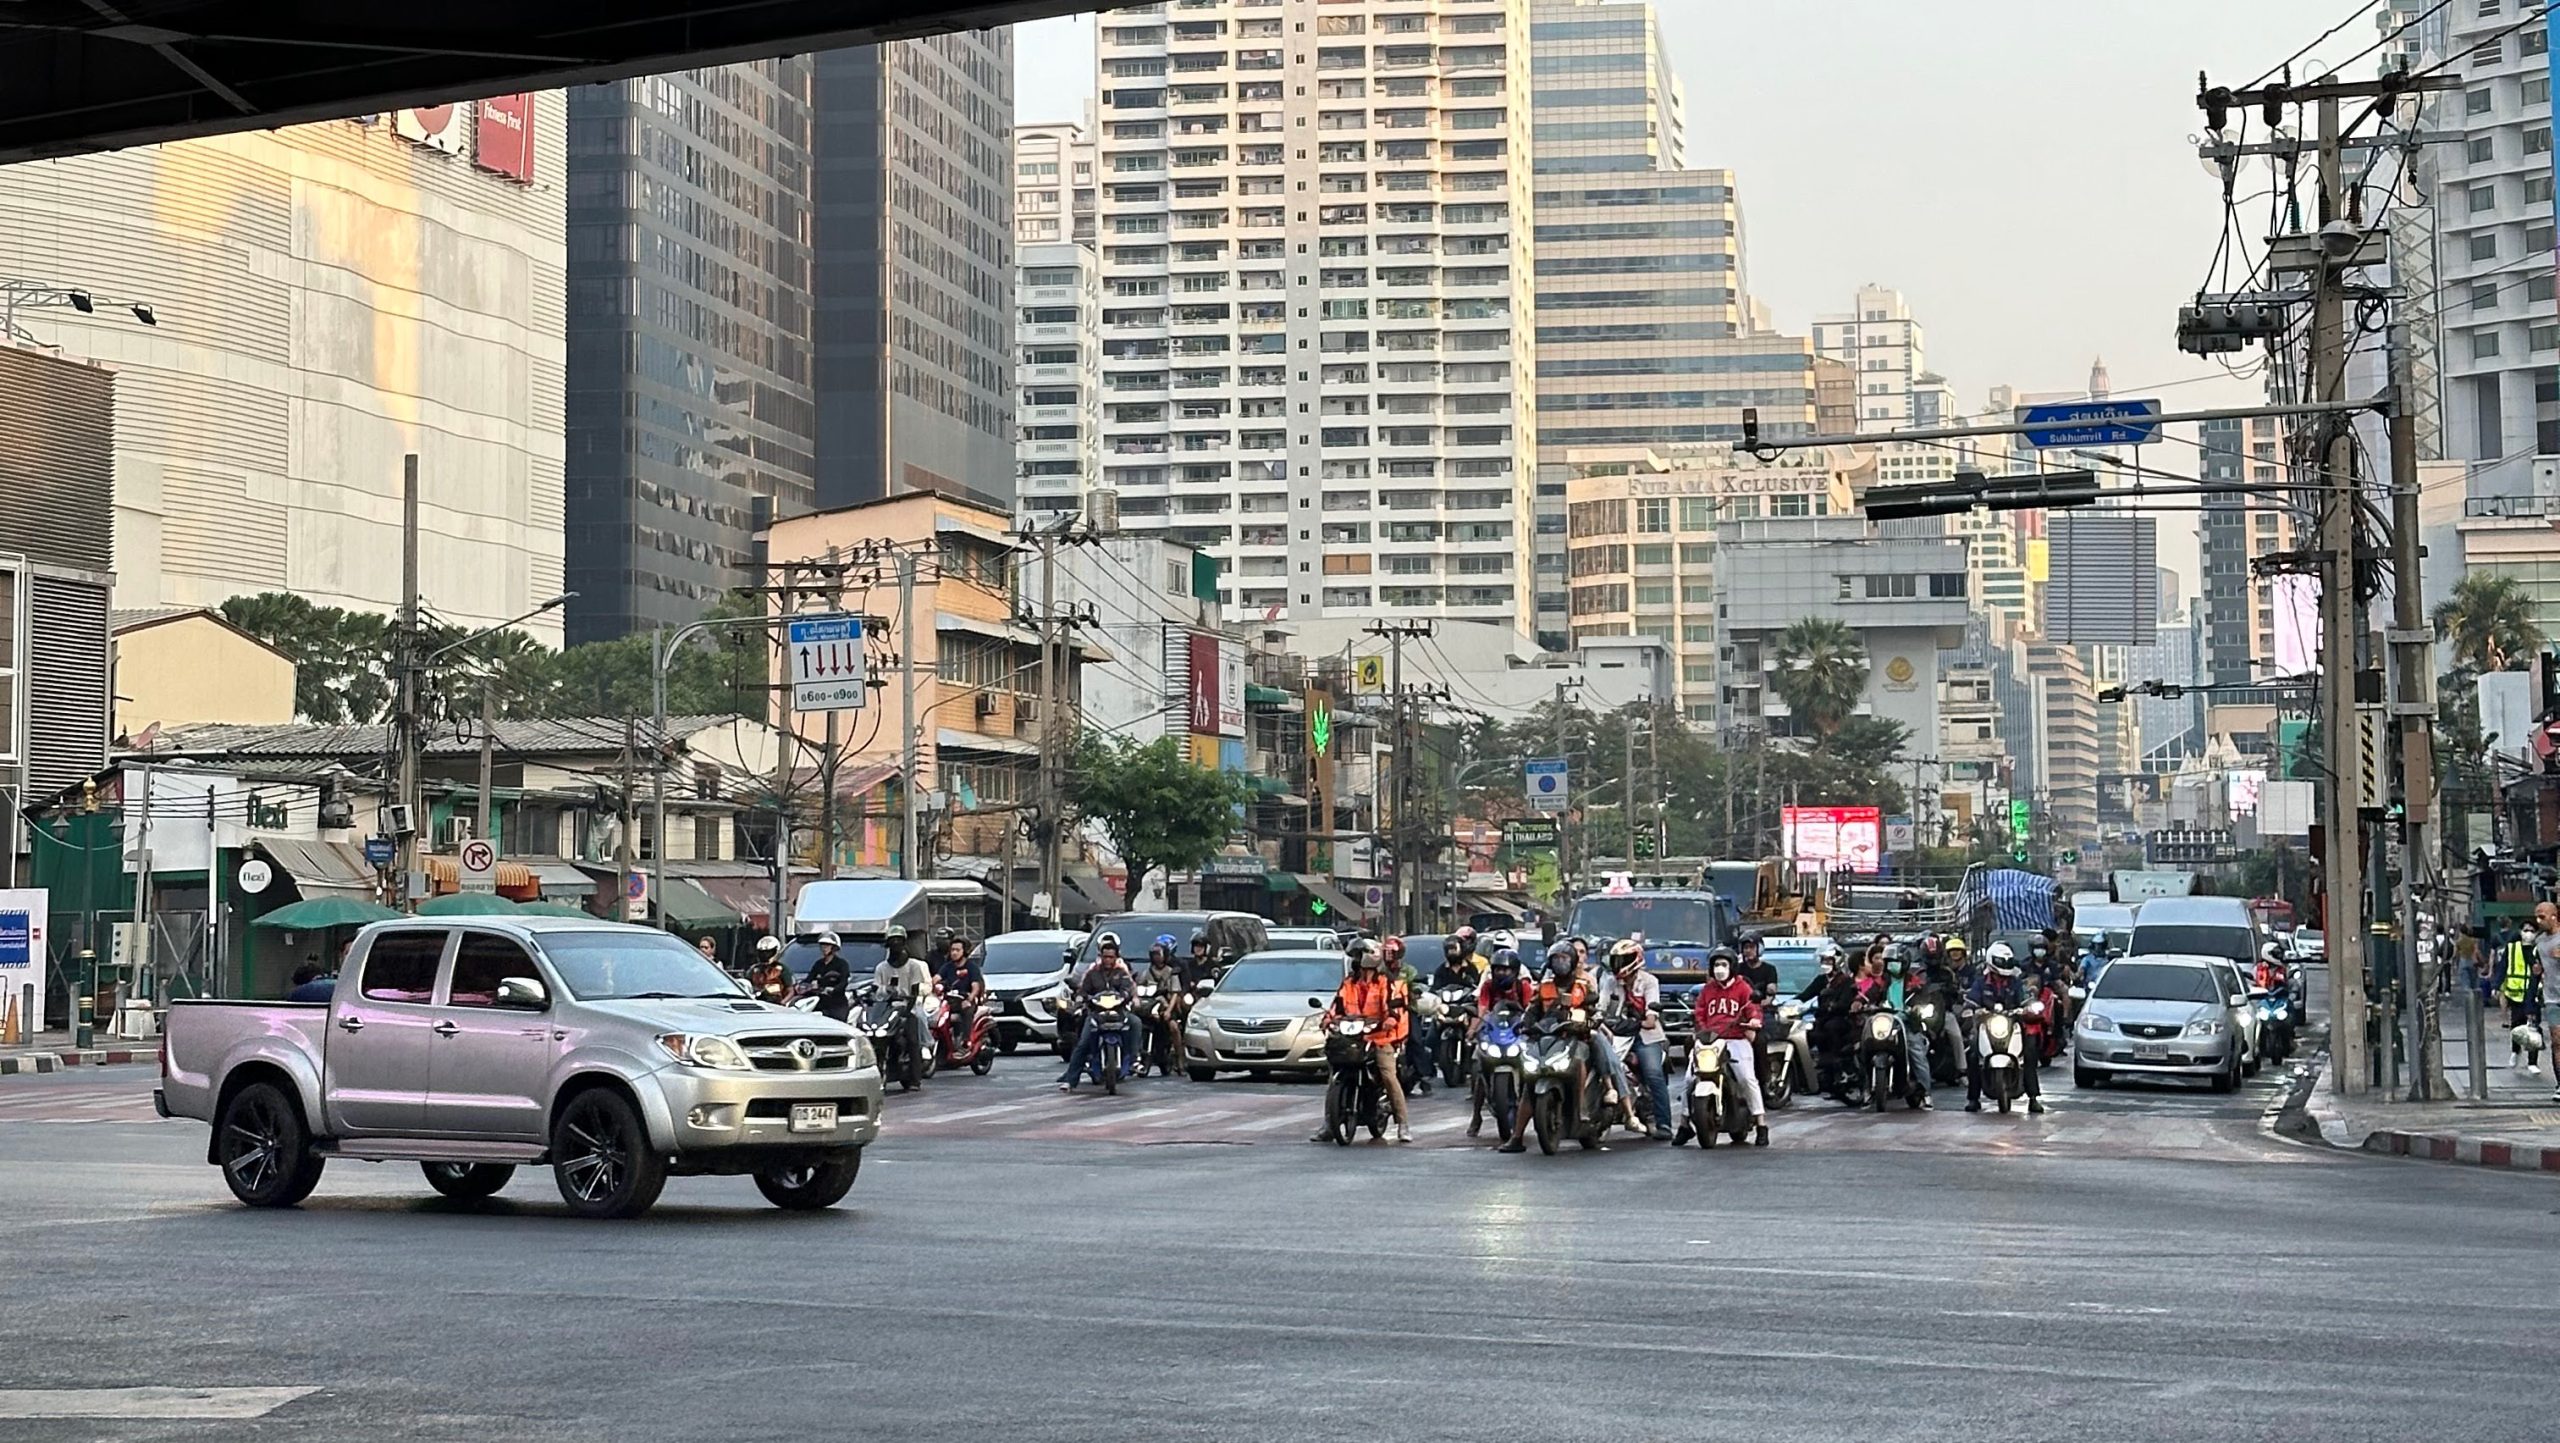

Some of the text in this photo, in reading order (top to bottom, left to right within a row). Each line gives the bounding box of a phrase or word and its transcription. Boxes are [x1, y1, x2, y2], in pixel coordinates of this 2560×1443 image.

[483, 101, 521, 131] Fitness First
[2049, 430, 2129, 443] Sukhumvit Rd.
[1720, 475, 1829, 493] XCLUSIVE
[1776, 938, 1808, 947] TAXI
[1708, 998, 1740, 1016] GAP
[811, 1107, 834, 1120] 2447
